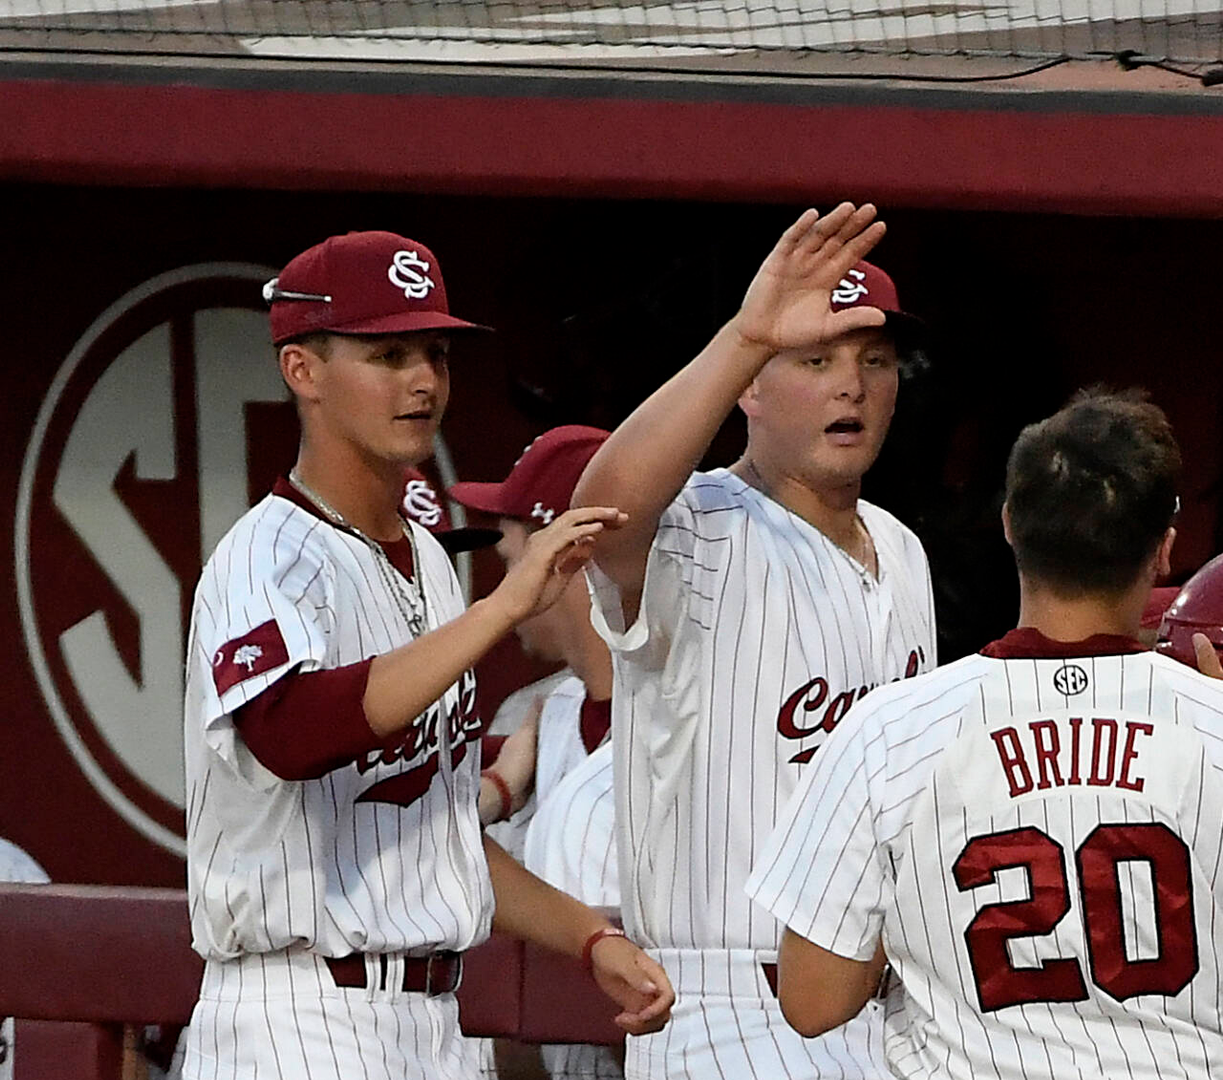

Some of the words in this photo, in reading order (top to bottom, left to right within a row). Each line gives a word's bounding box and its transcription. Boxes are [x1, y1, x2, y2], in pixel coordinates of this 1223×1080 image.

[1055, 666, 1087, 694] SEC
[990, 717, 1154, 798] BRIDE
[951, 822, 1200, 1013] 20
